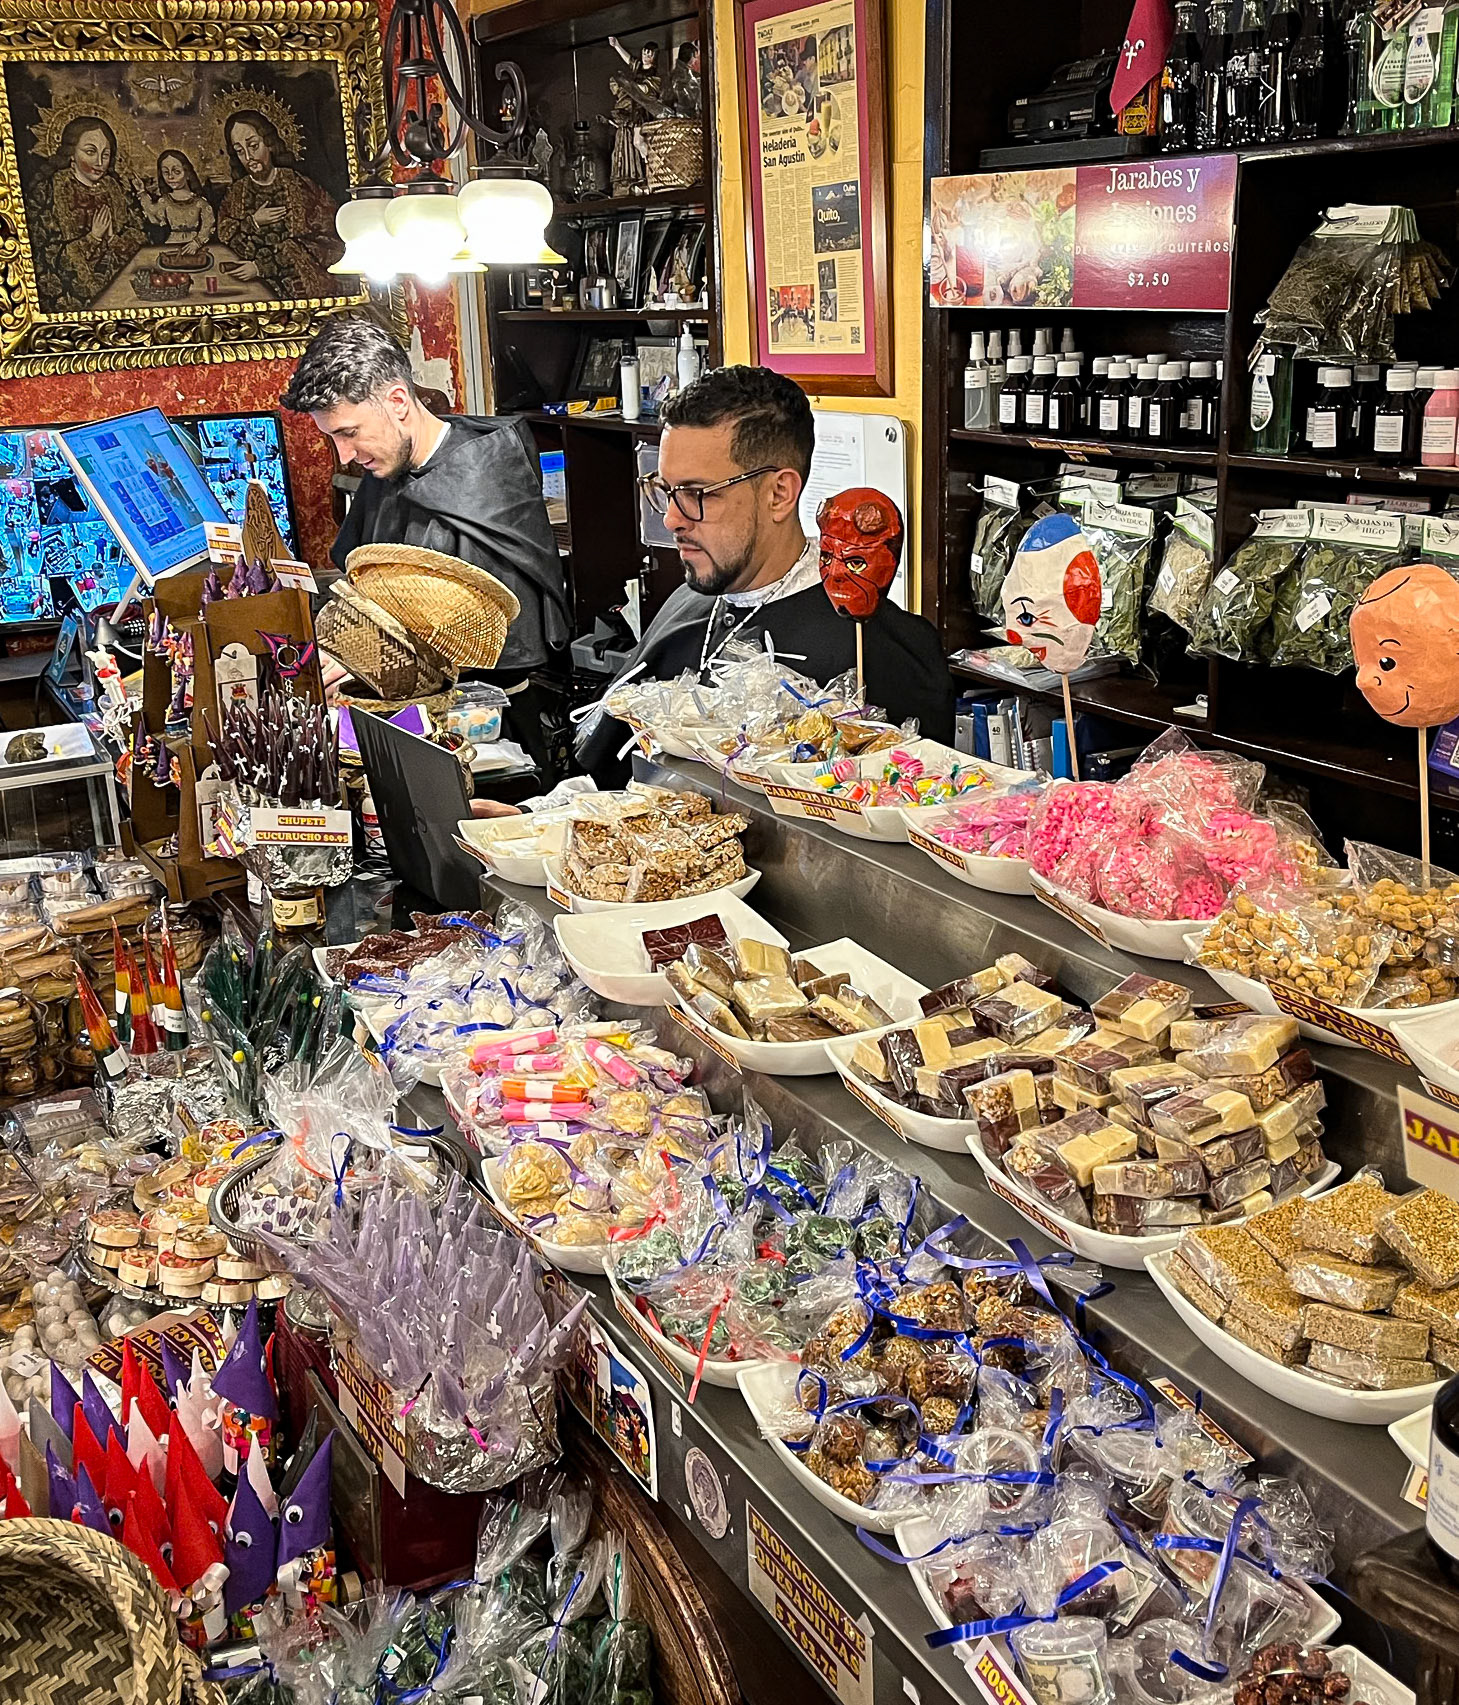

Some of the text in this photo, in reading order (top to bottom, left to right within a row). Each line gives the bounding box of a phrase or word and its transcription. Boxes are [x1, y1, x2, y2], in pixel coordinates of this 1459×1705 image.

[763, 156, 777, 168] San
[1106, 165, 1201, 193] Jarabes y
[1168, 240, 1230, 253] QUITEÑOS
[1127, 272, 1170, 287] $2,50
[1361, 526, 1386, 536] HIGO
[1383, 520, 1395, 528] DE
[821, 795, 860, 812] DIABLO
[804, 805, 834, 819] HUMA
[278, 816, 326, 826] CHUPETE
[256, 832, 321, 841] CUCURUCHO
[1269, 982, 1400, 1047] GELATINA
[1277, 1000, 1413, 1066] COLAGENO
[337, 1358, 406, 1457] CUCURUCHO
[752, 1512, 866, 1651] PROMOCION DE
[755, 1544, 860, 1676] QUESADILLAS
[786, 1614, 798, 1638] X
[800, 1631, 838, 1686] $3.75
